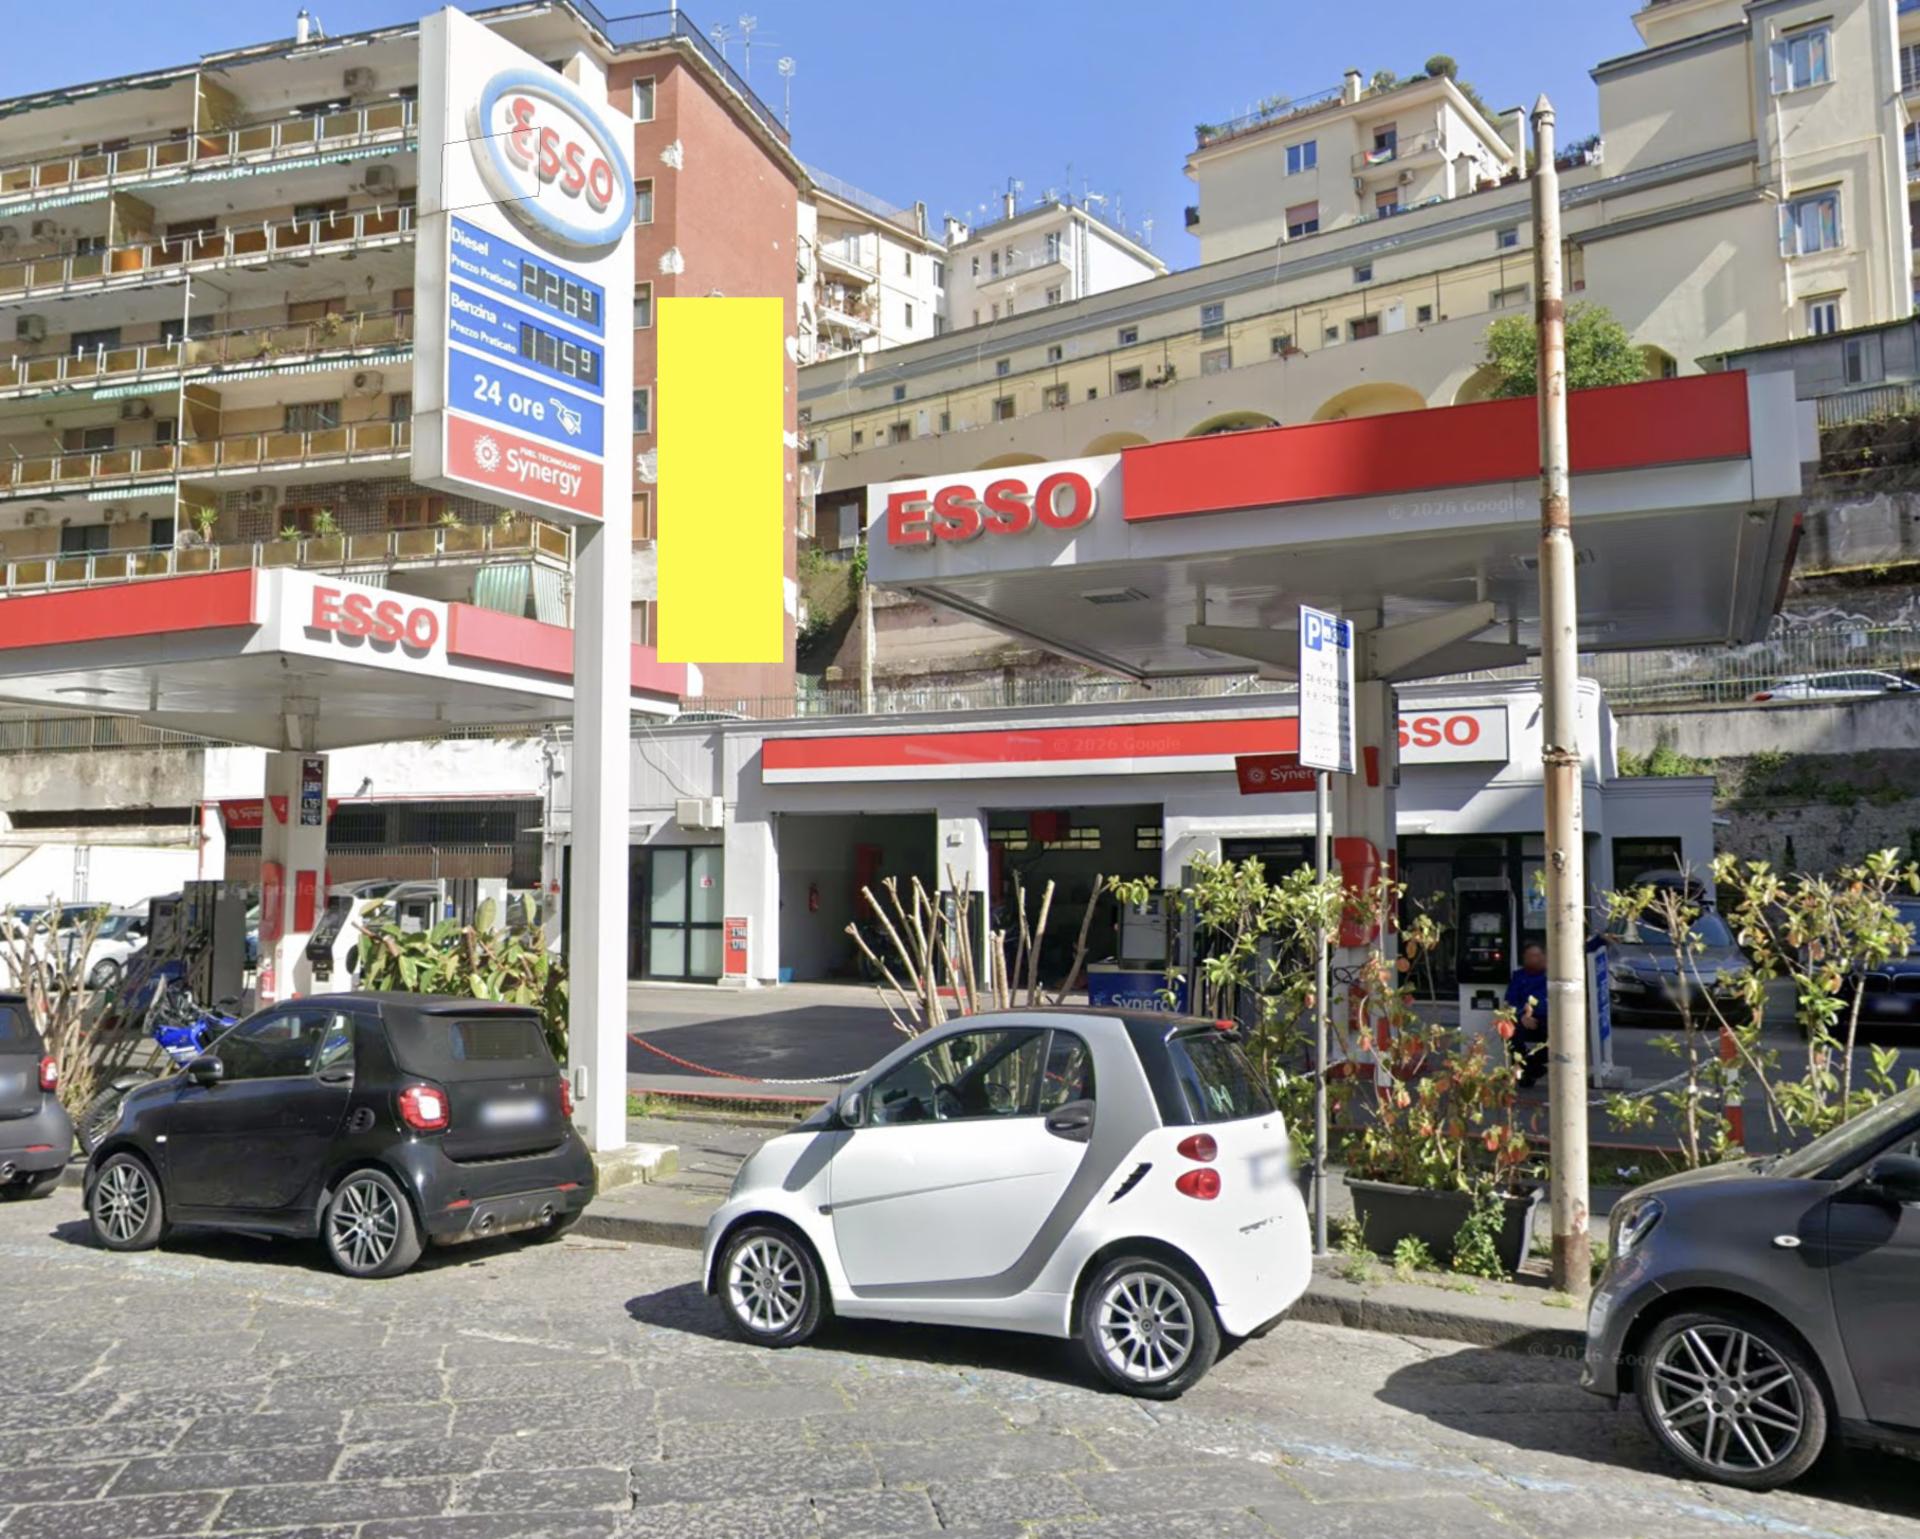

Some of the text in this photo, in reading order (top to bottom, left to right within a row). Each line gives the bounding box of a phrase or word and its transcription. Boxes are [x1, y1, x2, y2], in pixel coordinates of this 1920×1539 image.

[451, 227, 489, 257] Diesel
[451, 253, 480, 275] Prezzo
[480, 266, 518, 292] Praticato
[451, 292, 497, 325] Benzina
[450, 319, 479, 340] Prezzo
[480, 331, 518, 355] Praticato
[473, 374, 545, 421] 24 ore
[506, 448, 582, 497] Synergy
[886, 473, 1094, 546] ESSO
[309, 585, 439, 649] ESSO
